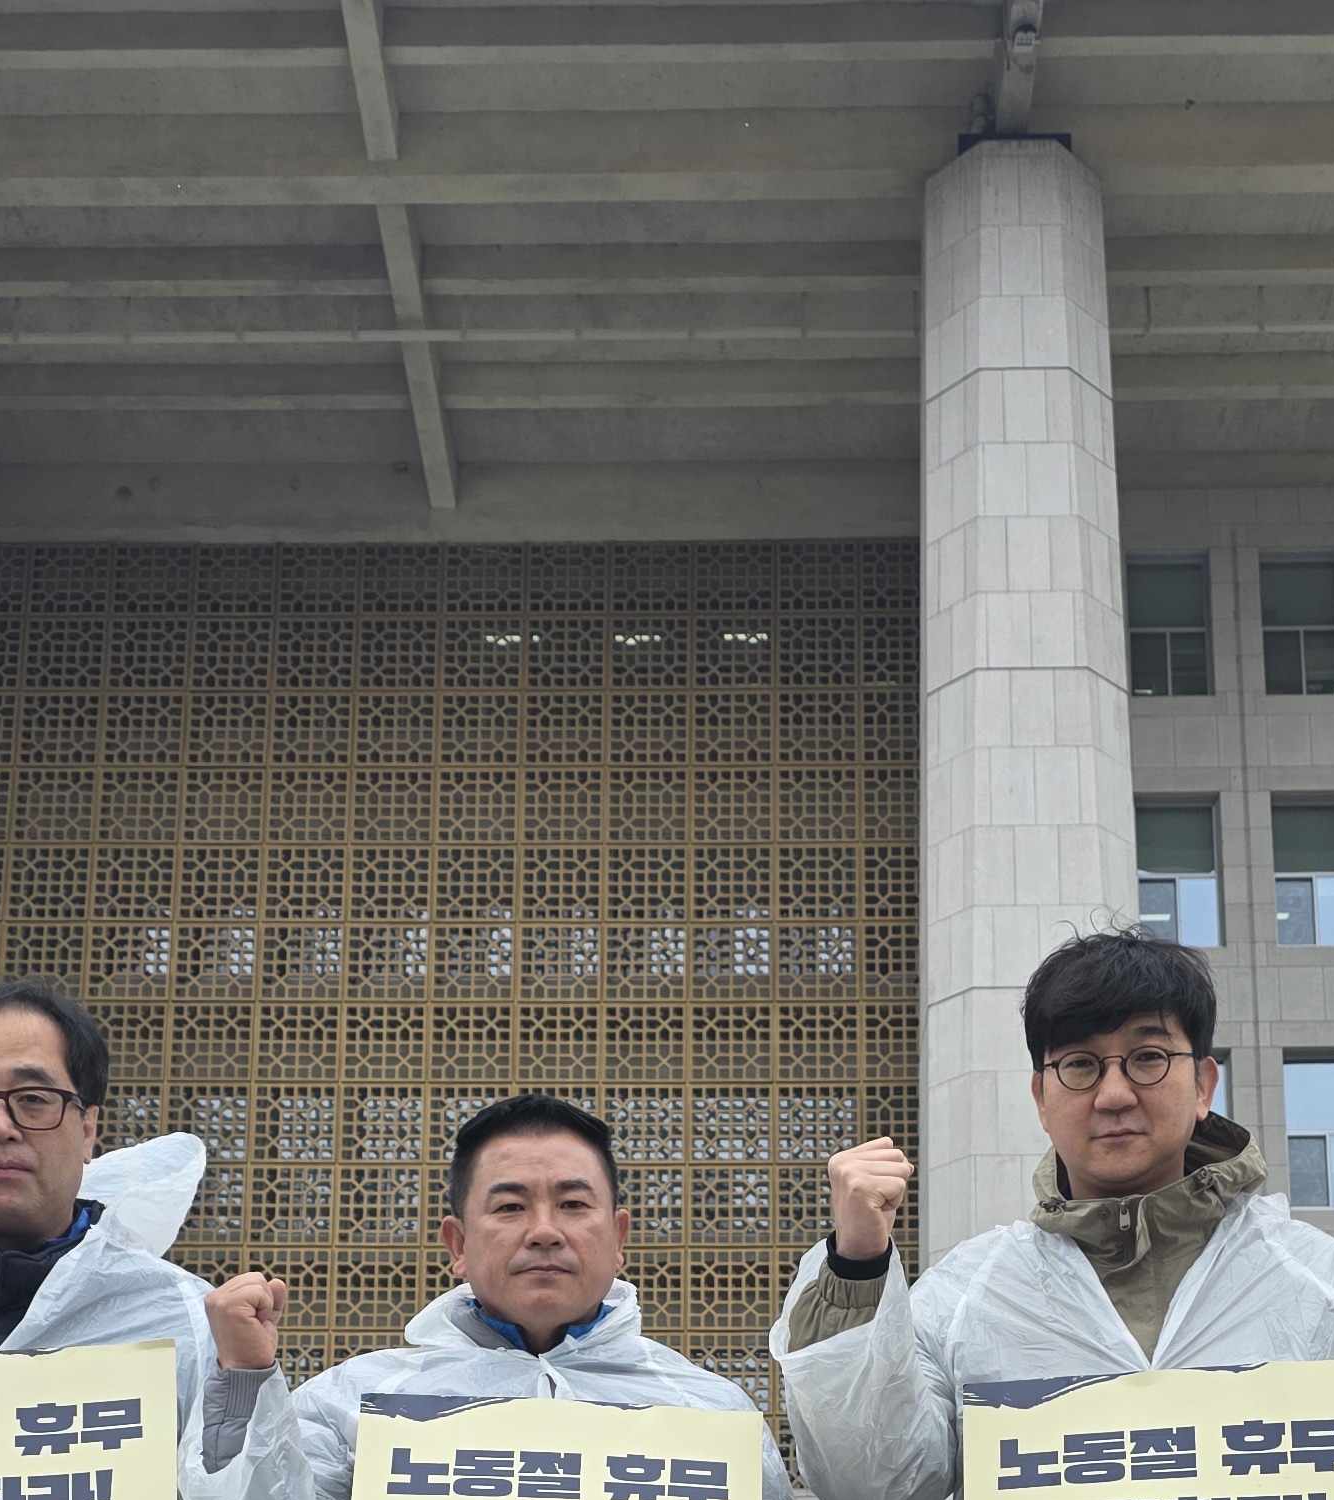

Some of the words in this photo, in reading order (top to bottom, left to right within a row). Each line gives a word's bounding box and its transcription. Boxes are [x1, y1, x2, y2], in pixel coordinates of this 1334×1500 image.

[14, 1397, 143, 1457] 휴무
[386, 1447, 582, 1500] 노동절
[997, 1425, 1198, 1491] 노동절
